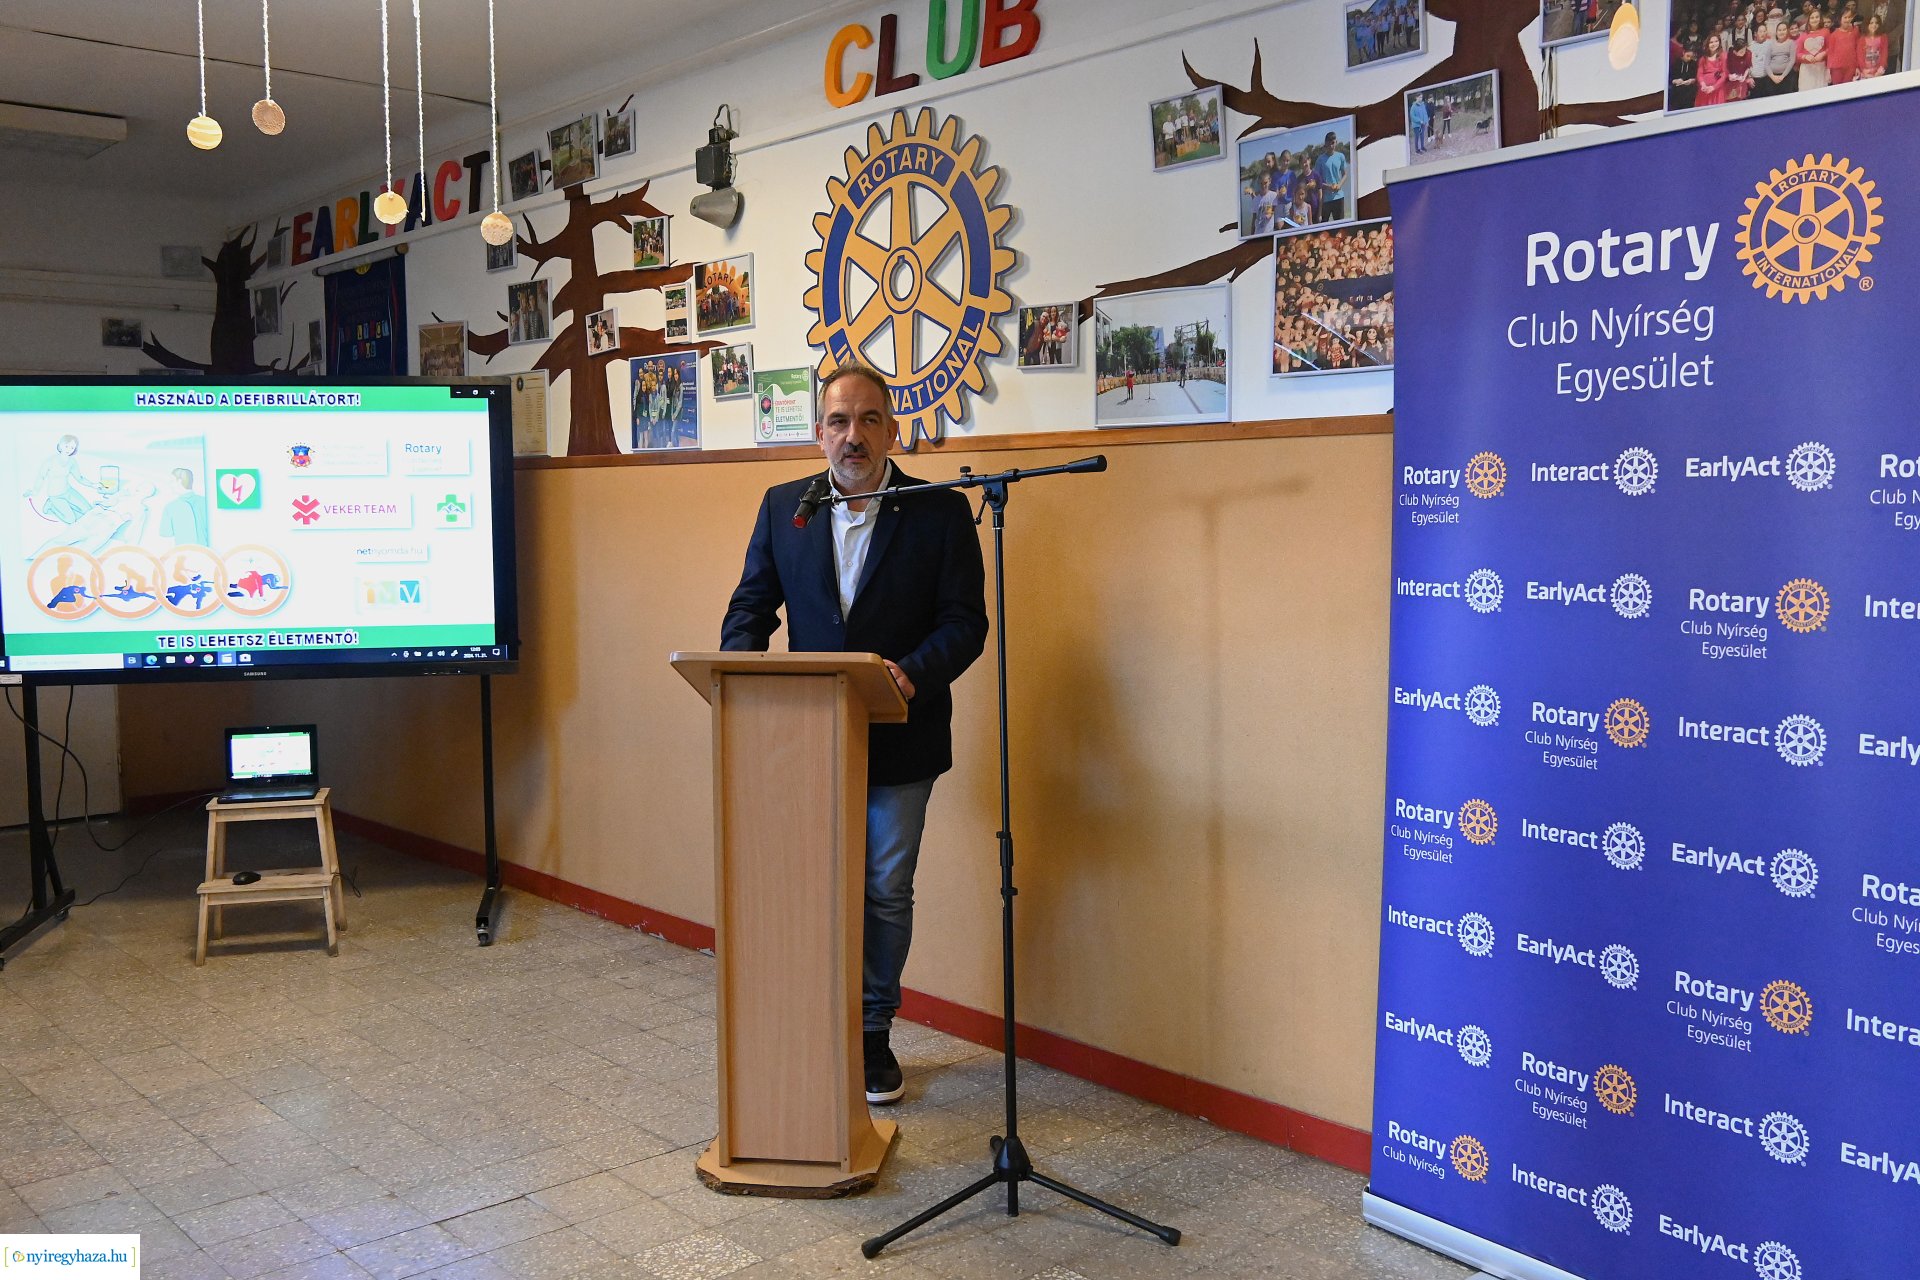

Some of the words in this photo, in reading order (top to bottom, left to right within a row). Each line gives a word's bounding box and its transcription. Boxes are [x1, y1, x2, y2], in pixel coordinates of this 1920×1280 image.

[825, 0, 1041, 108] CLUB
[858, 146, 944, 198] ROTARY
[1778, 170, 1839, 193] ROTARY
[1526, 222, 1719, 286] Rotary
[1757, 245, 1859, 289] INTERNATIONAL
[1508, 311, 1578, 347] Club
[1591, 299, 1714, 348] Nyírség
[836, 322, 981, 412] INATIONAL
[1557, 353, 1714, 402] Egyesület
[136, 390, 214, 406] HASZNÁLD
[219, 393, 230, 406] A
[234, 390, 360, 406] DEFIBRILLÁTORT!
[405, 443, 442, 455] Rotary
[1403, 466, 1460, 488] Rotary
[1531, 462, 1608, 481] Interact
[1686, 456, 1780, 481] EarlyAct
[1880, 453, 1920, 479] Ro
[324, 504, 361, 515] VEKER
[365, 504, 397, 514] TEAM
[1400, 494, 1419, 506] Club
[1421, 493, 1459, 509] Nyírség
[1870, 489, 1906, 505] Club
[1412, 511, 1459, 525] Egyesület
[1397, 578, 1460, 598] Interact
[1527, 581, 1606, 606] EarlyAct
[1689, 588, 1770, 618] Rotary
[158, 636, 175, 648] TE
[181, 636, 194, 648] IS
[199, 635, 263, 648] LEHETSZ
[268, 631, 358, 646] ÉLETMENTŐ!
[1680, 620, 1712, 636] Club
[1717, 621, 1767, 641] Nyírség
[1702, 642, 1767, 659] Egyesület
[1395, 687, 1460, 711] EarlyAct
[1532, 702, 1599, 732] Rotary
[1679, 716, 1770, 746] Interact
[1525, 730, 1551, 746] Club
[1556, 737, 1598, 754] Nyírség
[1543, 751, 1598, 770] Egyesület
[1395, 798, 1454, 829] Rotary
[1391, 825, 1411, 839] Club
[1414, 830, 1453, 849] Nyírség
[1522, 819, 1598, 849] Interact
[1404, 844, 1453, 864] Egyesület
[1672, 842, 1765, 876] EarlyAct
[1388, 905, 1453, 936] Interact
[1852, 907, 1888, 926] Club
[1894, 915, 1920, 934] Nyí
[1517, 933, 1595, 968] EarlyAct
[1675, 970, 1754, 1012] Rotary
[1386, 1011, 1453, 1046] EarlyAct
[1666, 1000, 1697, 1019] Club
[1702, 1008, 1752, 1035] Nyírség
[1687, 1025, 1752, 1053] Egyesület
[1522, 1051, 1589, 1092] Rotary
[1515, 1078, 1541, 1097] Club
[1545, 1087, 1587, 1113] Nyírség
[1533, 1101, 1587, 1129] Egyesület
[1665, 1093, 1753, 1137] Interact
[1389, 1120, 1446, 1159] Rotary
[1382, 1146, 1406, 1162] Club
[1409, 1154, 1445, 1180] Nyírség
[1512, 1163, 1587, 1207] Interact
[1659, 1214, 1748, 1264] EarlyAct
